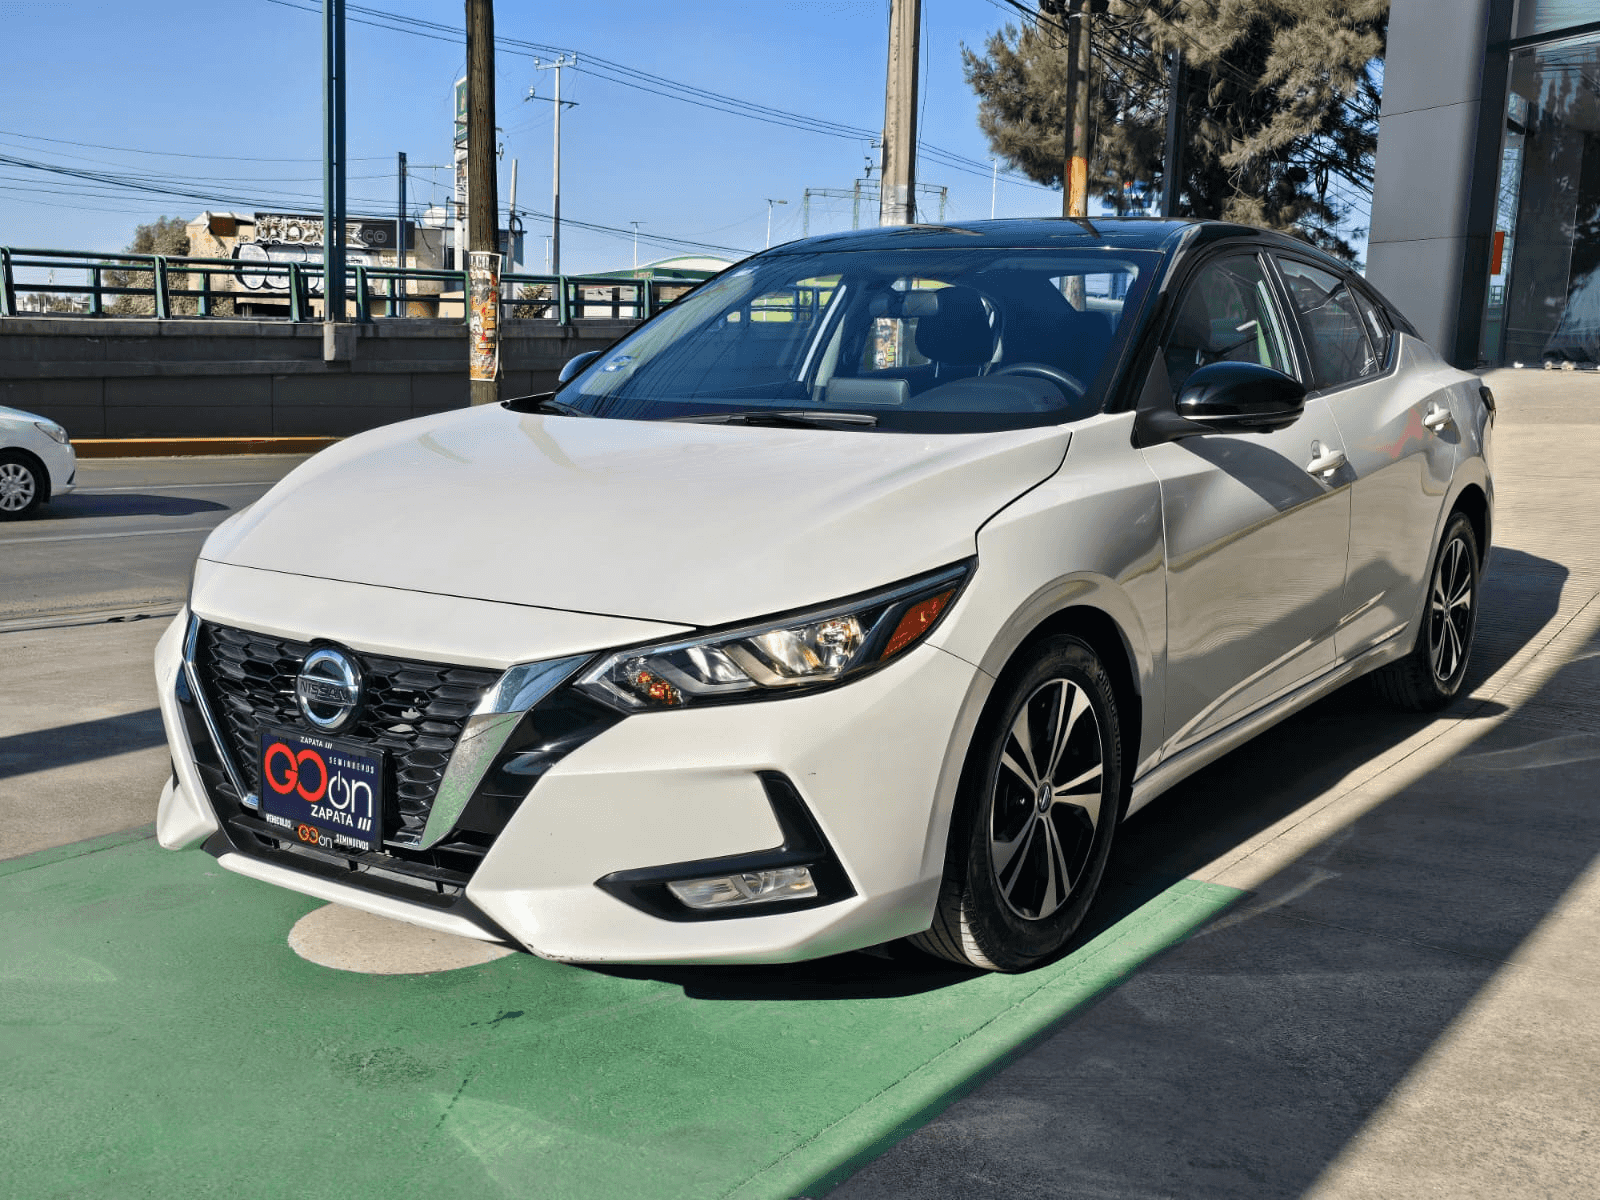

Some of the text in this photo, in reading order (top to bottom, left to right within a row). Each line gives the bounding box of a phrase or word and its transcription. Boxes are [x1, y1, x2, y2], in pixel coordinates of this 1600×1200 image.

[301, 680, 348, 701] NISSAN
[300, 736, 323, 748] ZAPATA
[311, 804, 354, 828] ZAPATA
[335, 833, 369, 851] SEMINUEVOS
